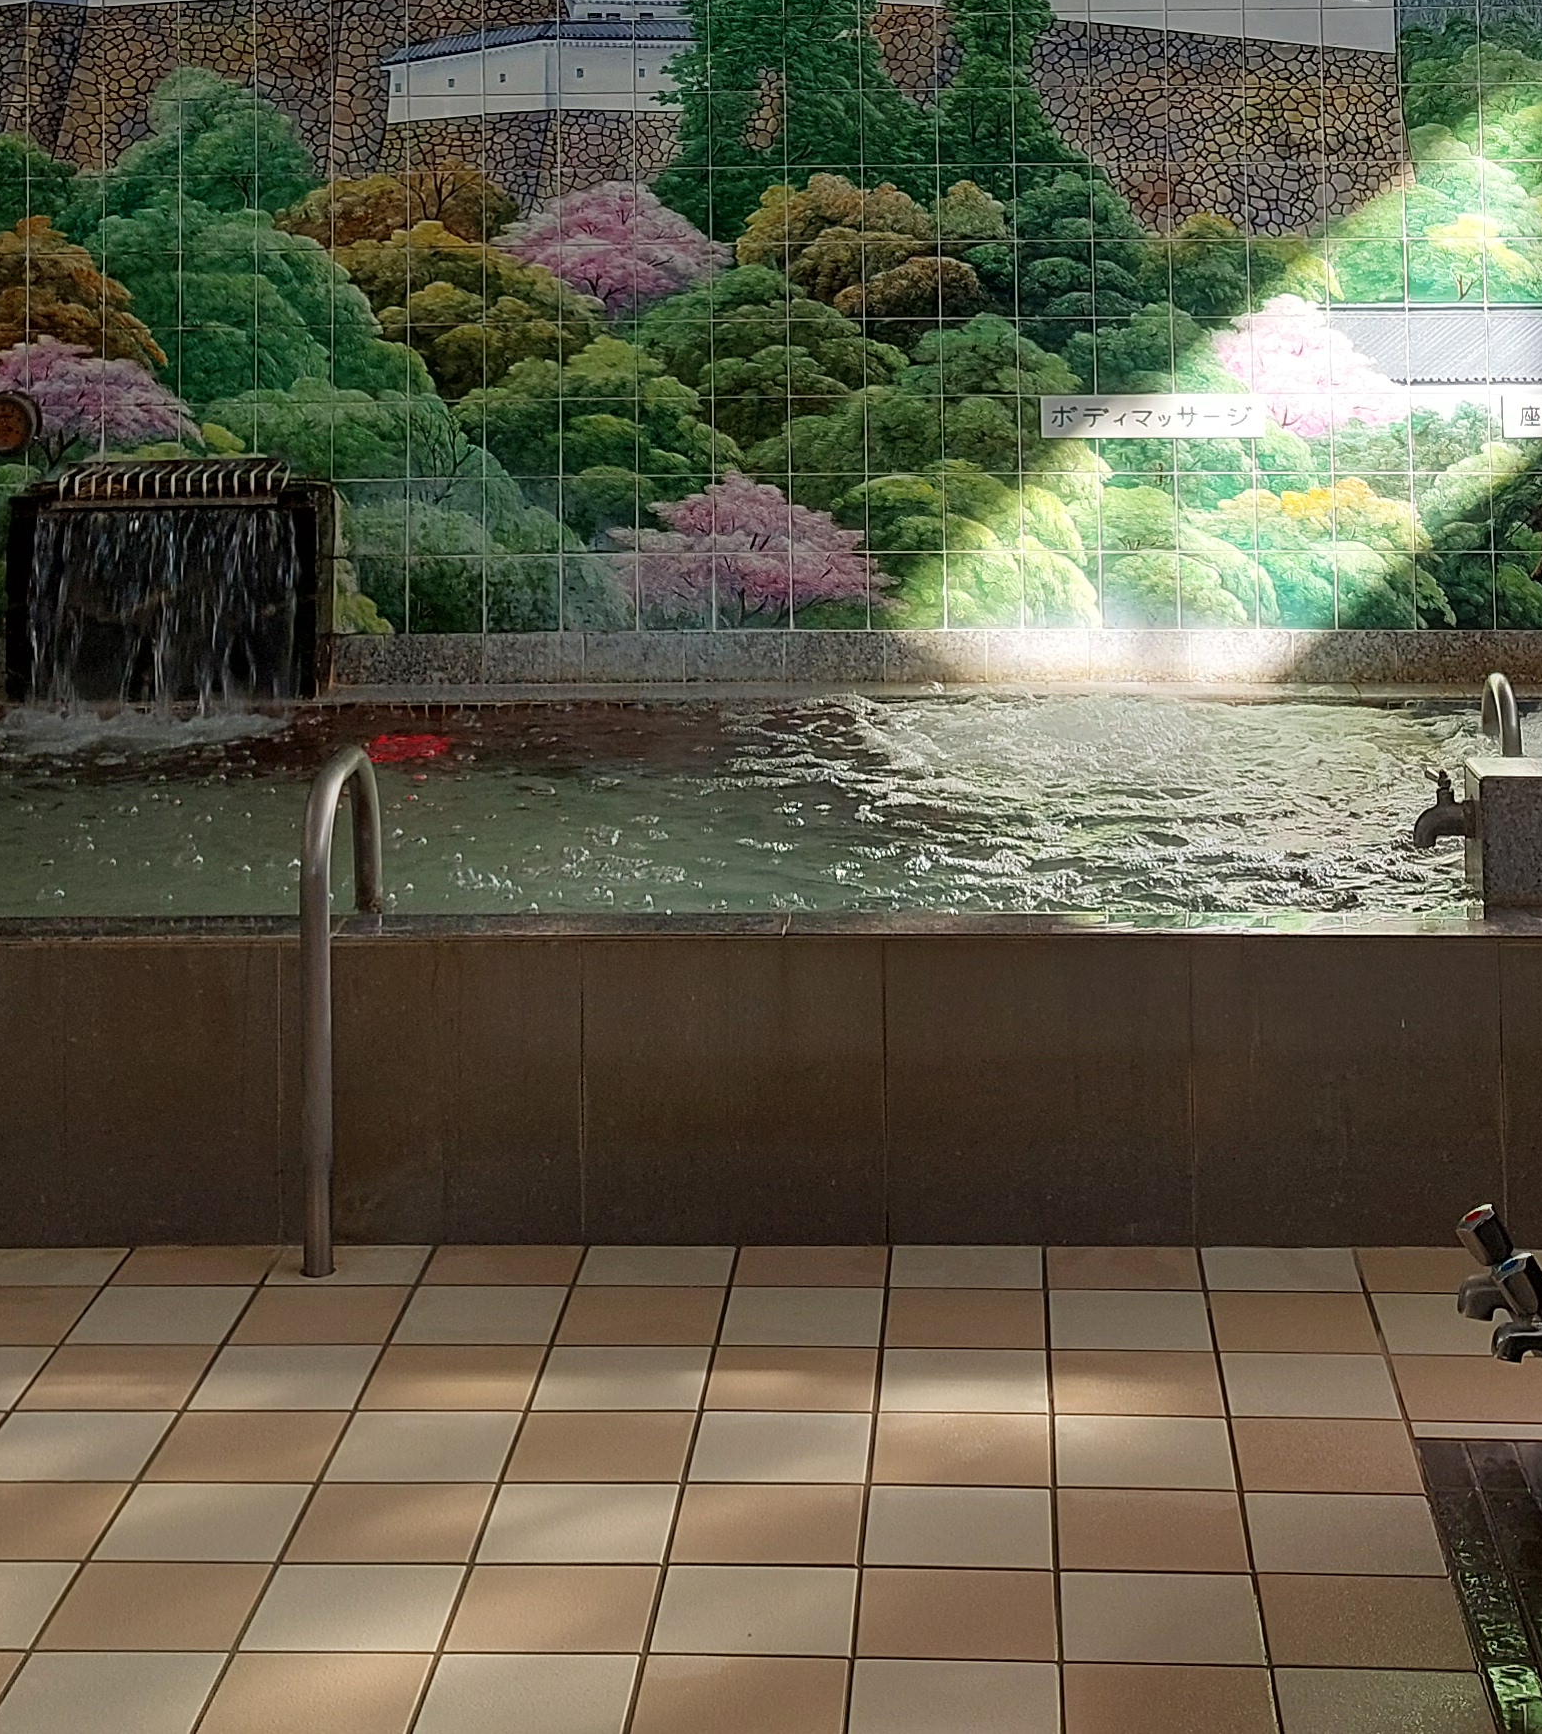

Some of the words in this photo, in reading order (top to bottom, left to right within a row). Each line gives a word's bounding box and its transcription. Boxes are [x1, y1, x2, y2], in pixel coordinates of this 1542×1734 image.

[1050, 404, 1253, 428] ボディマッサージ
